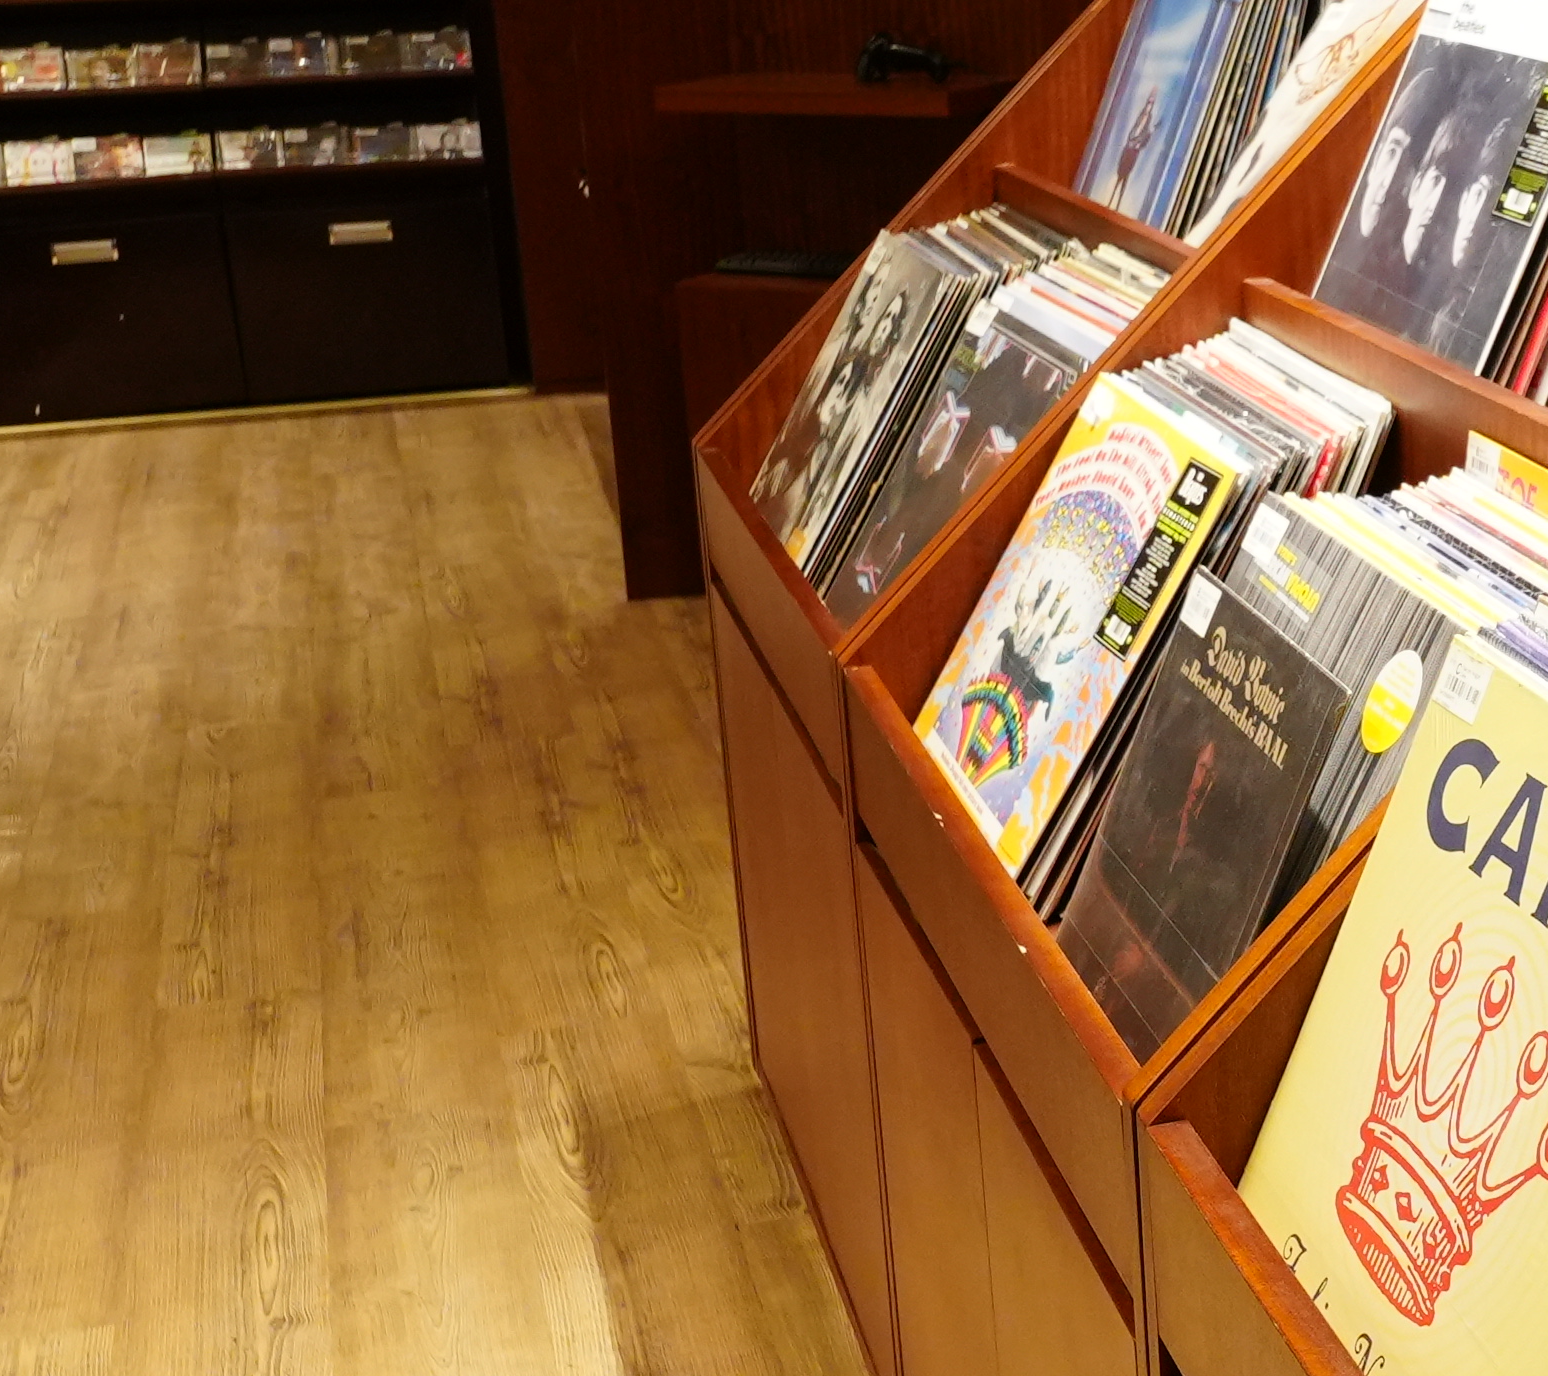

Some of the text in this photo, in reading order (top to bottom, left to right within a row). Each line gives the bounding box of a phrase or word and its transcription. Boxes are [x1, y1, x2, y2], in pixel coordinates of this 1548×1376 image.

[1207, 625, 1246, 687] David
[1244, 655, 1286, 725] Bowie
[1254, 721, 1288, 771] BAAL
